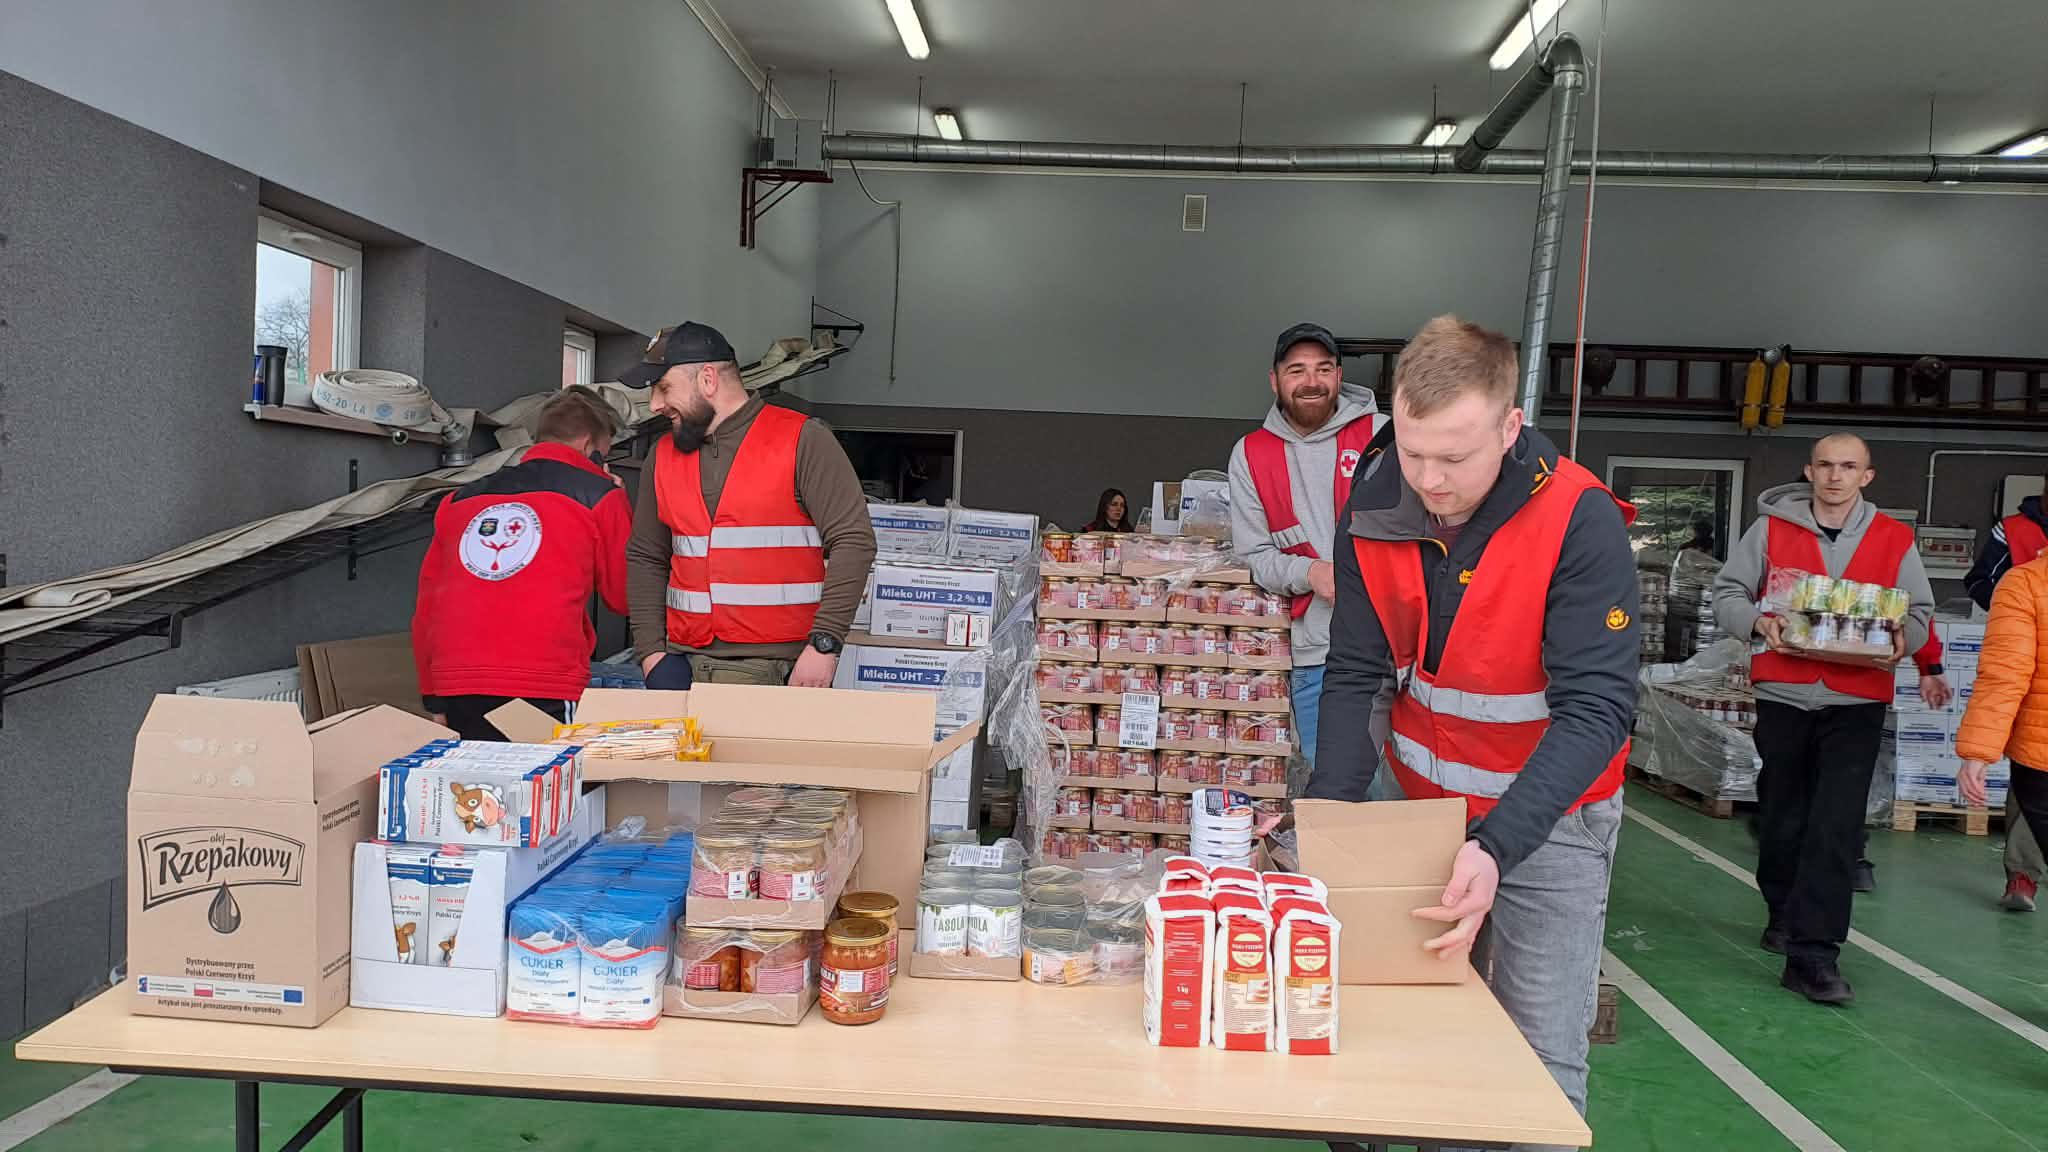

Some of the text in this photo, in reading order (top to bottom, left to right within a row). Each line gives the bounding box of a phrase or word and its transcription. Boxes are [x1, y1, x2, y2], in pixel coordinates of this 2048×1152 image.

[881, 588, 913, 599] Mleko
[915, 591, 937, 601] UHT
[948, 593, 965, 603] 3,2
[863, 669, 897, 680] Mleko
[900, 671, 923, 681] UHT
[209, 832, 226, 846] olej
[152, 837, 292, 885] Rzepakowy
[933, 916, 965, 931] FASOLA
[520, 955, 564, 969] CUKIER
[185, 967, 205, 977] Polski
[592, 964, 639, 977] CUKIER
